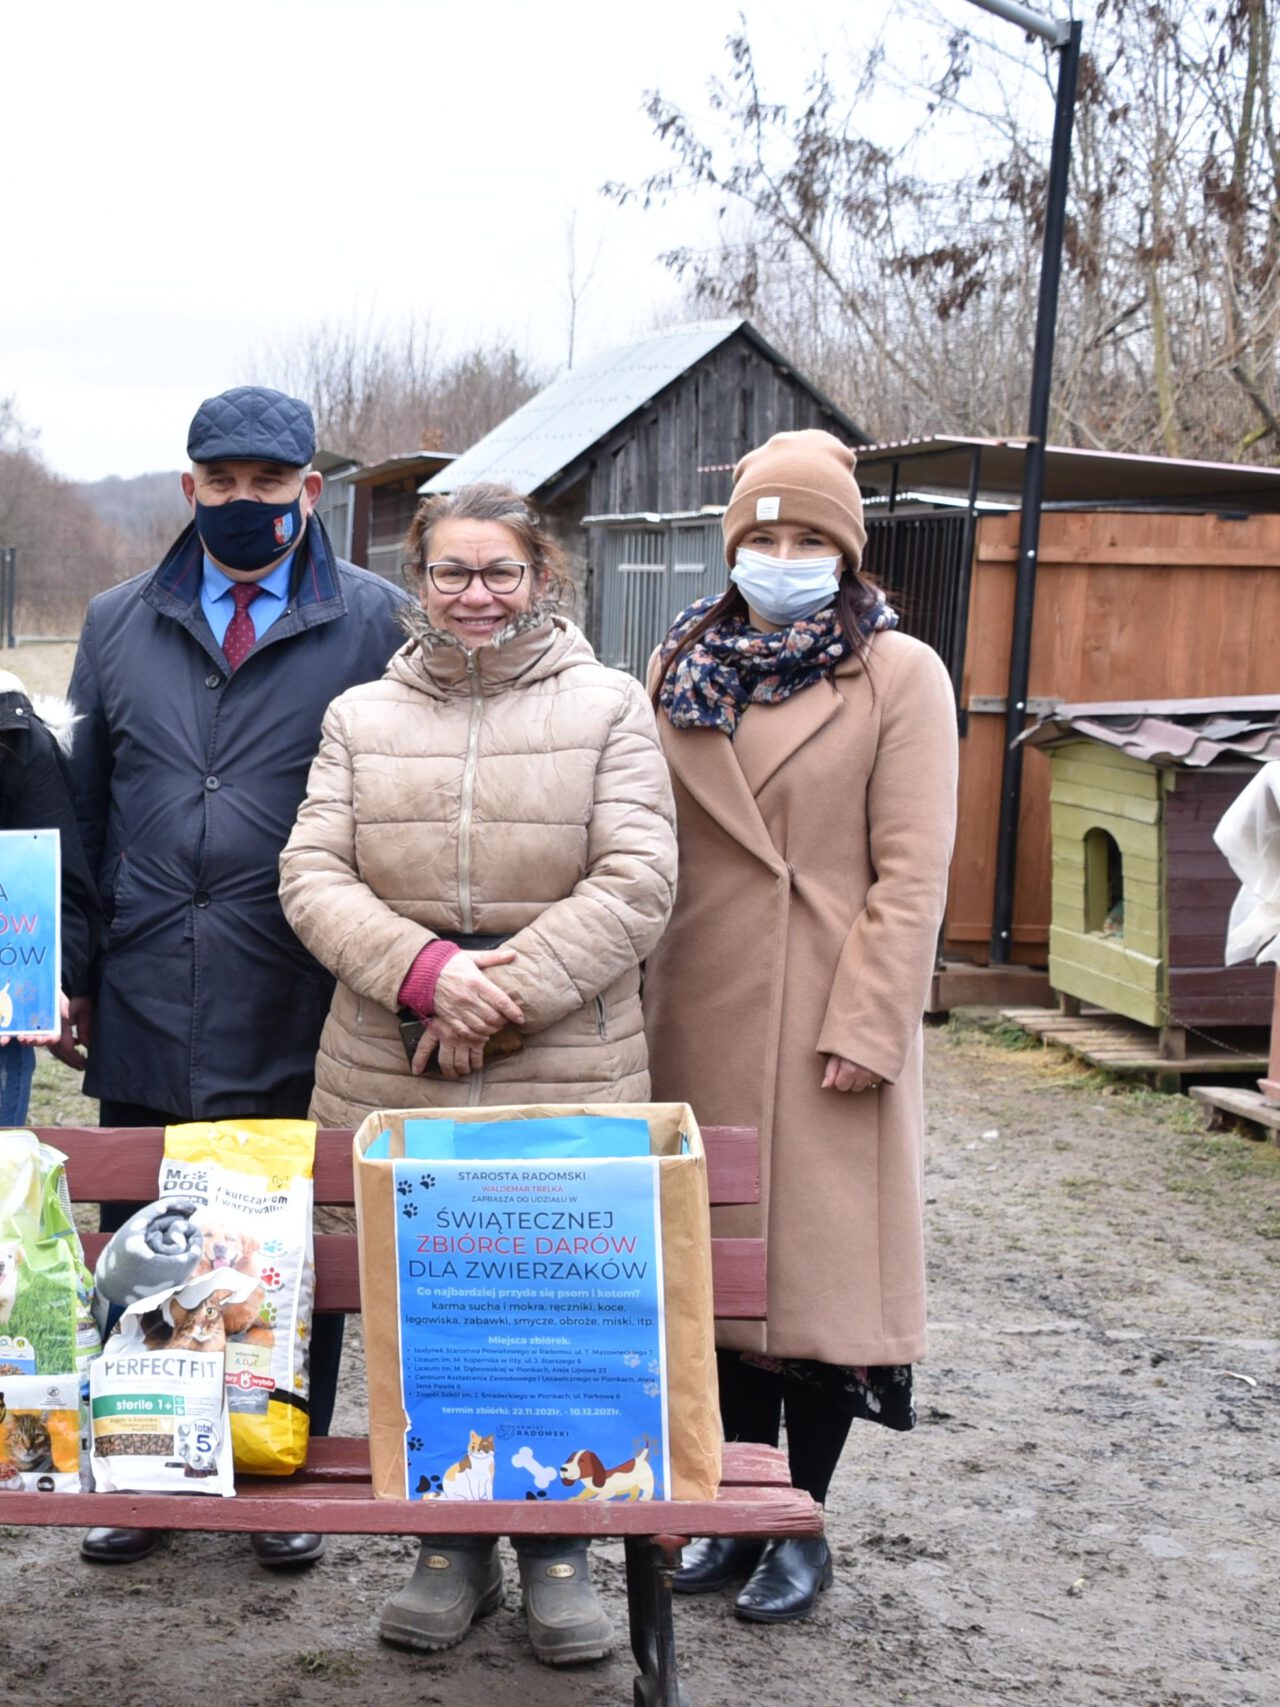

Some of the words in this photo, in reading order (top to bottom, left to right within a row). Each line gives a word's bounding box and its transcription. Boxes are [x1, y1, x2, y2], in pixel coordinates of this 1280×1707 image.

[458, 1172, 519, 1181] STAROSTA
[522, 1171, 586, 1181] RADOMSKI
[163, 1180, 209, 1193] DOG
[482, 1185, 530, 1193] WALDEMAR
[532, 1185, 564, 1193] TRELKA
[471, 1195, 515, 1203] ZAPRASZA
[516, 1195, 530, 1203] DO
[569, 1195, 578, 1203] W
[436, 1207, 614, 1234] ŚWIĄTECZNEJ
[416, 1232, 527, 1254] ZBIÓRCE
[535, 1232, 638, 1255] DARÓW
[408, 1260, 458, 1279] DLA
[465, 1258, 648, 1280] ZWIERZAKÓW
[416, 1286, 432, 1296] Co
[434, 1287, 496, 1298] najbardziej
[498, 1287, 537, 1299] przyda
[539, 1288, 555, 1298] się
[557, 1289, 590, 1298] psom
[597, 1288, 641, 1298] kotom?
[431, 1301, 466, 1311] karma
[468, 1301, 500, 1311] sucha
[509, 1302, 548, 1312] mokra,
[549, 1303, 595, 1313] ręczniki,
[405, 1315, 461, 1326] legowiska,
[463, 1315, 511, 1325] zabawki,
[513, 1317, 557, 1328] smycze,
[559, 1316, 600, 1326] obroże,
[602, 1317, 635, 1327] miski,
[637, 1316, 655, 1327] itp.
[488, 1336, 528, 1346] Miejsca
[530, 1335, 571, 1345] zbiórek:
[104, 1358, 187, 1377] PERFECT
[190, 1360, 217, 1378] FIT
[116, 1399, 154, 1411] sterile
[157, 1399, 173, 1411] 1+
[441, 1406, 474, 1414] termin
[475, 1407, 509, 1415] zbiórki:
[512, 1407, 563, 1416] 22.11.2021r.
[570, 1408, 622, 1416] 10.12.2021r.
[516, 1430, 570, 1438] RADOMSKI
[196, 1433, 212, 1453] 5
